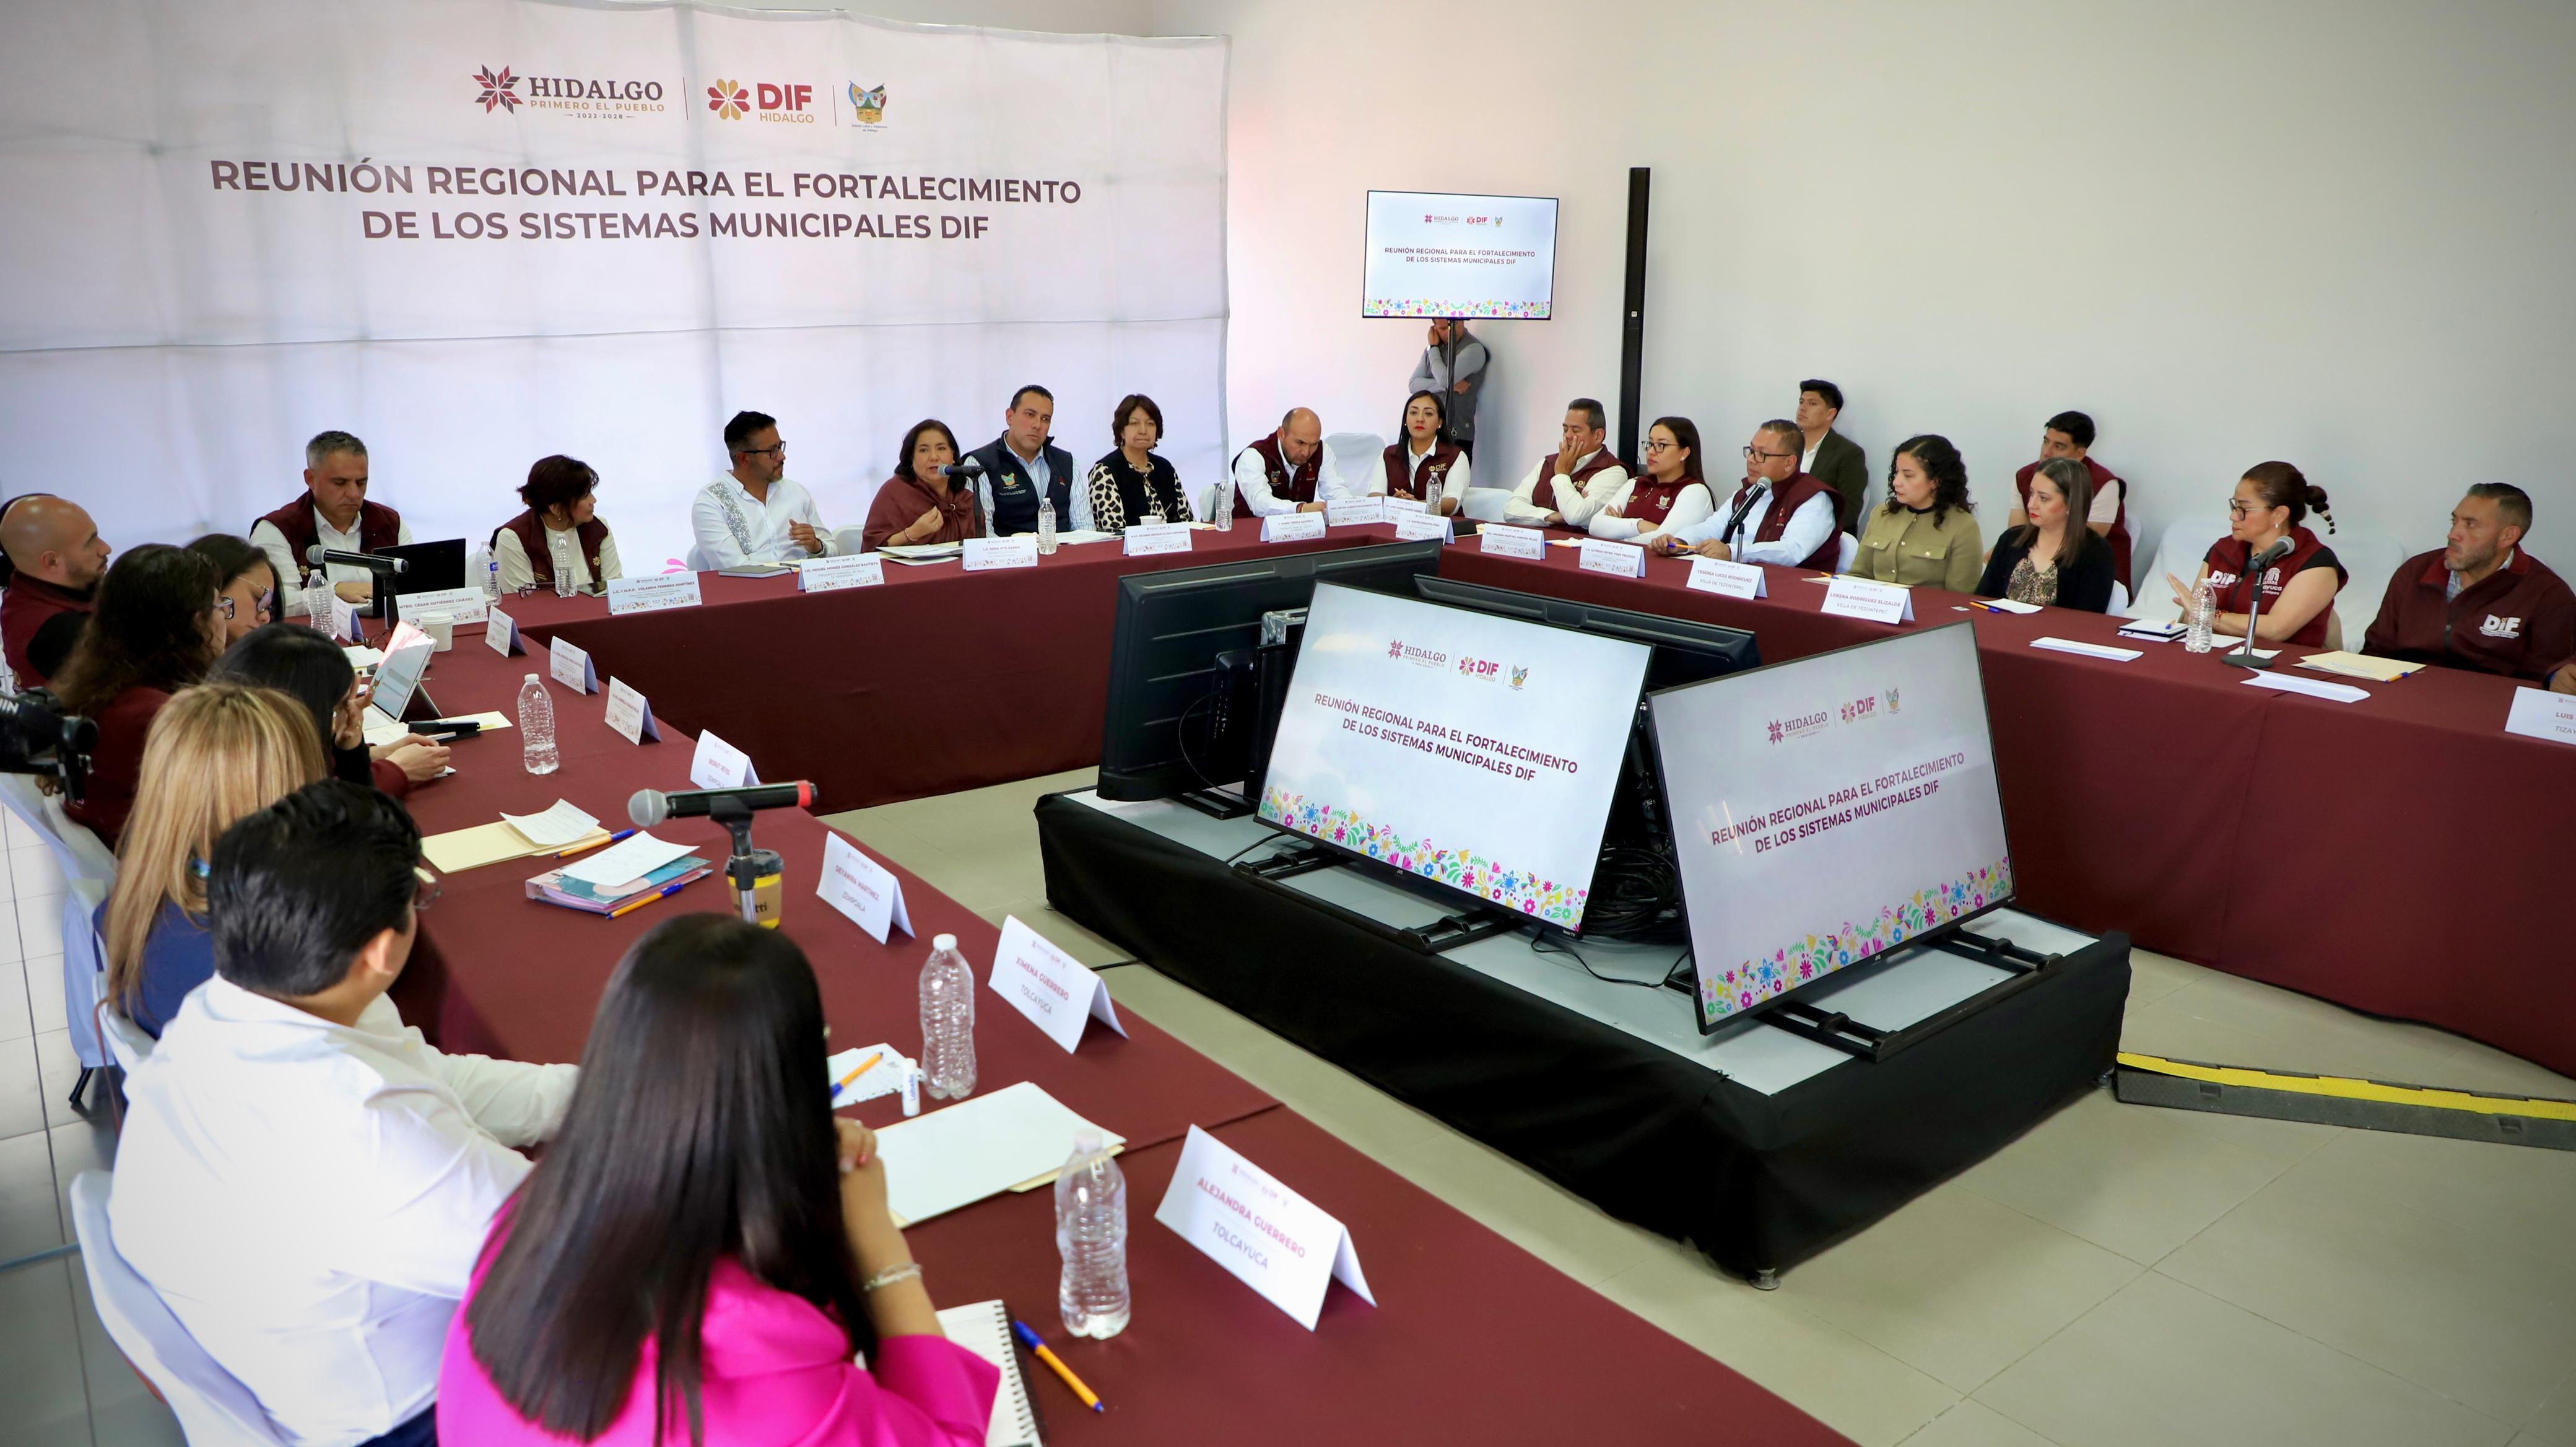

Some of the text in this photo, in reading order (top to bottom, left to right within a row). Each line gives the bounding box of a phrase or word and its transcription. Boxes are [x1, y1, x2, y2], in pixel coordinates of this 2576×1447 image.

[528, 77, 663, 100] HIDALGO
[757, 83, 812, 111] DIF
[530, 100, 590, 110] PRIMERO
[616, 103, 664, 111] PUEBLO
[759, 112, 814, 124] HIDALGO
[211, 157, 1081, 204] REUNIÓN REGIONAL PARA EL FORTALECIMIENTO
[362, 211, 989, 239] DE LOS SISTEMAS MUNICIPALES DIF
[1850, 595, 1877, 603] RODRÍGUEZ
[1404, 645, 1447, 663] HIDALGO
[1476, 660, 1499, 676] DIF
[1475, 673, 1495, 682] HIDALGO
[1856, 696, 1875, 714] DIF
[2556, 712, 2574, 720] LUIS
[1315, 693, 1578, 774] REUNIÓN REGIONAL PARA EL FORTALECIMIENTO
[1784, 712, 1827, 732] HIDALGO
[1342, 718, 1536, 781] DE LOS SISTEMAS MUNICIPALES DIF
[1712, 752, 1964, 846] REUNIÓN REGIONAL PARA EL FORTALECIMIENTO
[1755, 780, 1939, 853] DE LOS SISTEMAS MUNICIPALES DIF
[1016, 956, 1069, 1001] XIMENA GUERRERO
[1020, 984, 1052, 1015] TOLCAYUCA
[1197, 1177, 1305, 1258] ALEJANDRA GUERRERO
[1212, 1221, 1268, 1269] TOLCAYUCA
